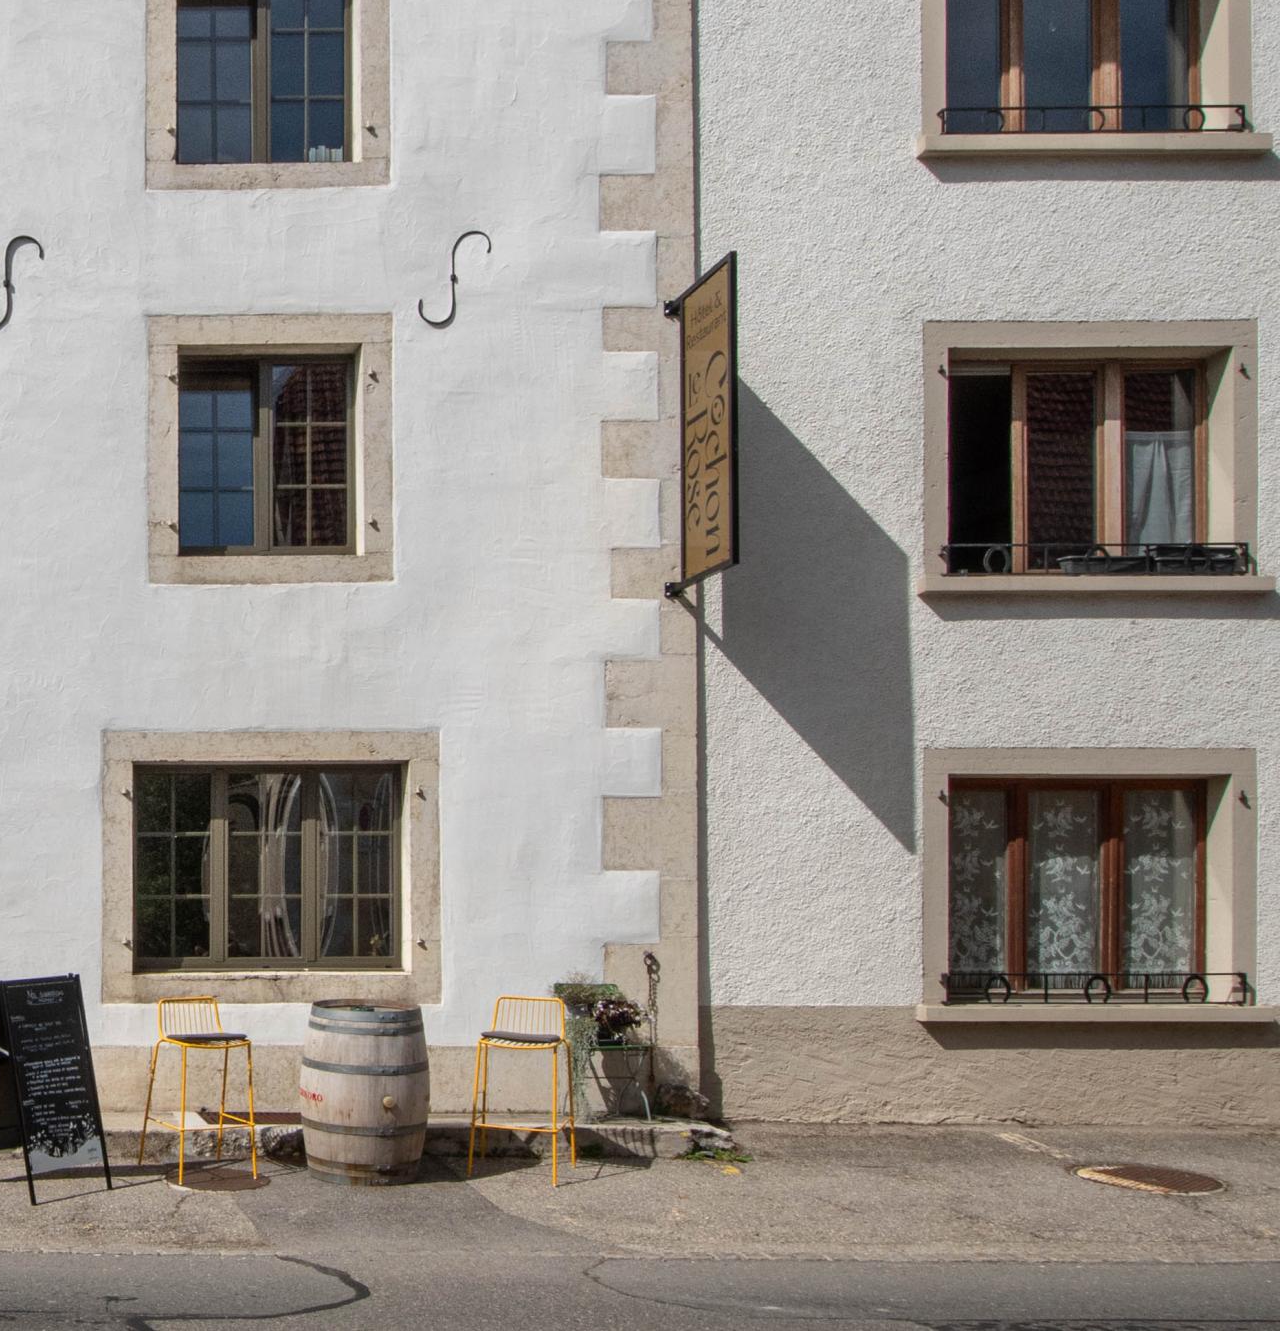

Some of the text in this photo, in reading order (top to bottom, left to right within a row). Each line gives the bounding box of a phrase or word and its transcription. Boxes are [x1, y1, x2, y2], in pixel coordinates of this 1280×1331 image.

[686, 309, 727, 350] Restaurant
[689, 289, 723, 329] Hôtel &
[686, 410, 708, 533] Rose
[704, 350, 728, 557] Cochon
